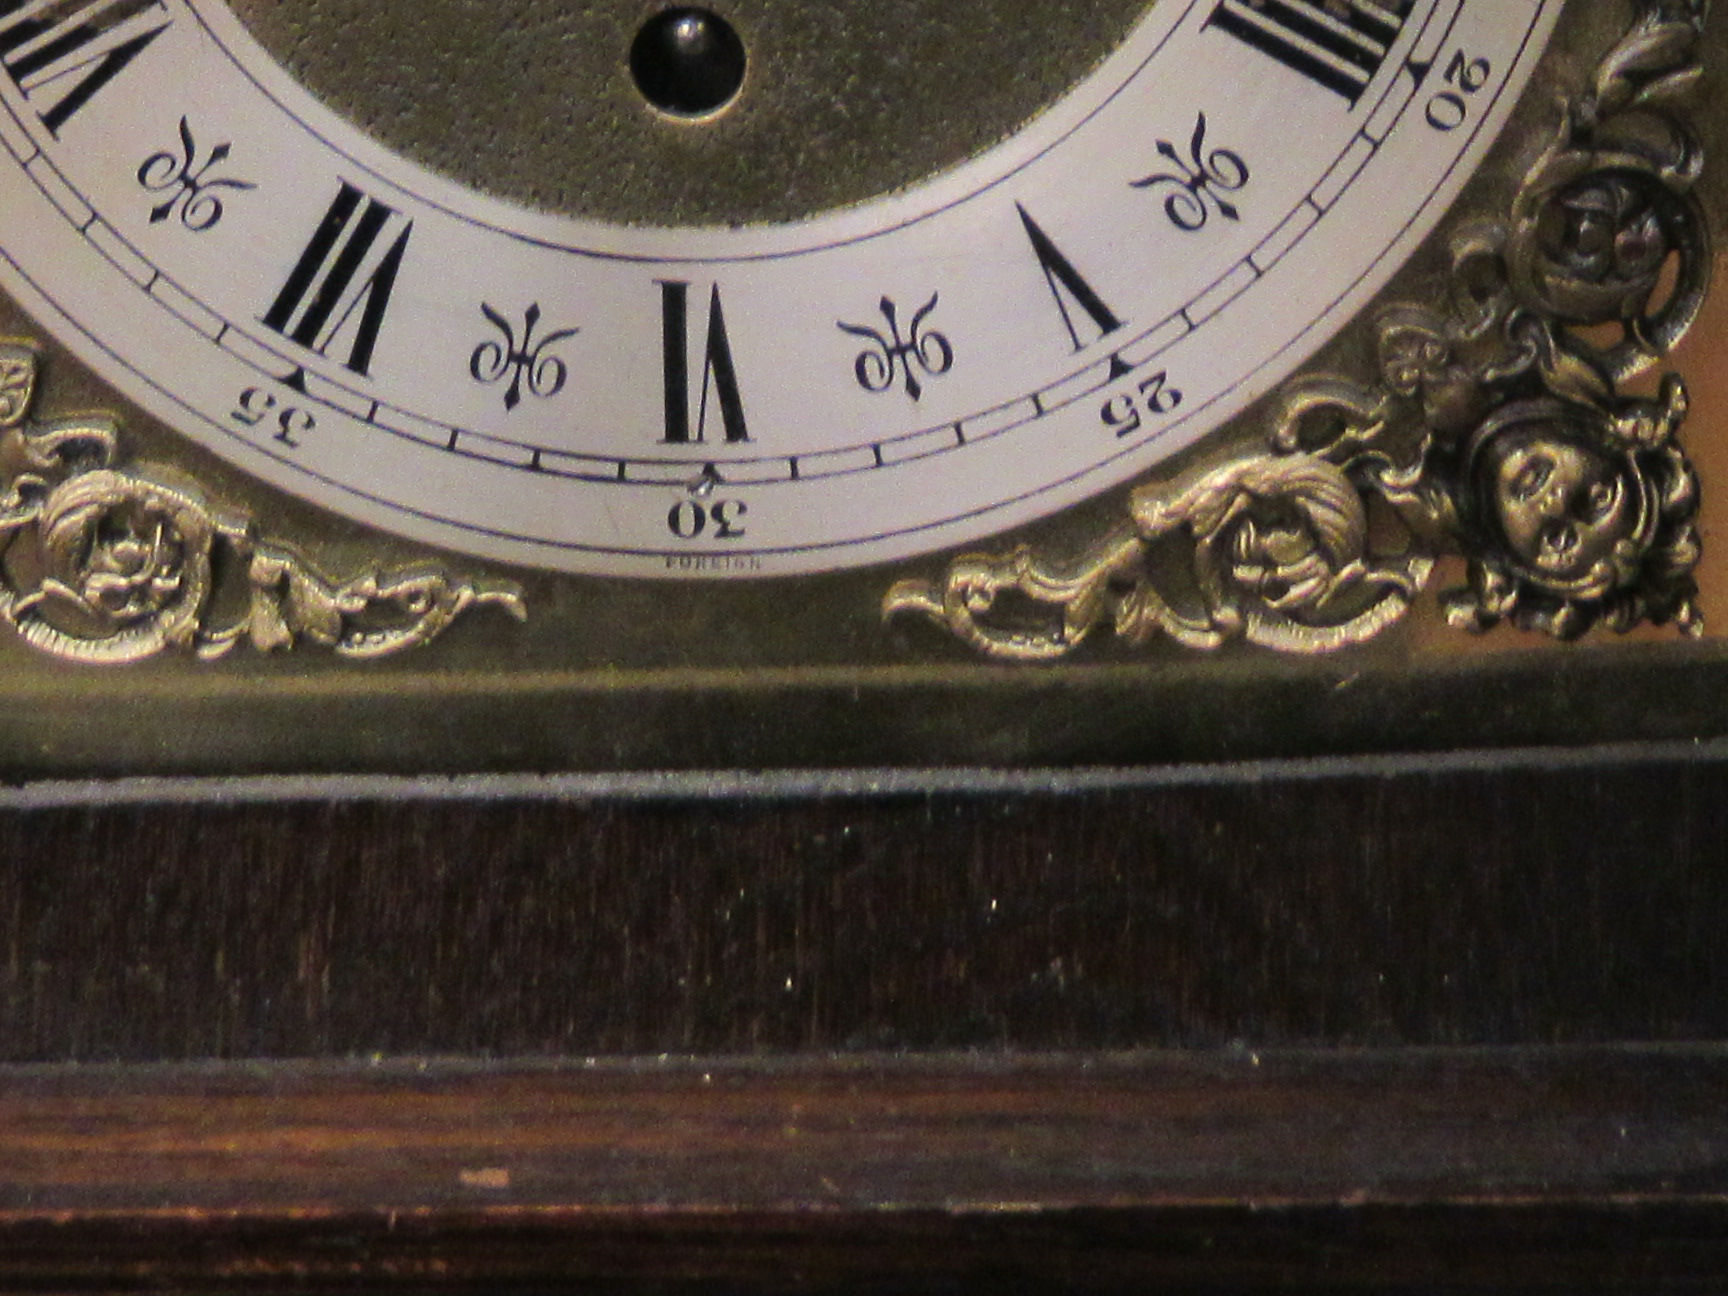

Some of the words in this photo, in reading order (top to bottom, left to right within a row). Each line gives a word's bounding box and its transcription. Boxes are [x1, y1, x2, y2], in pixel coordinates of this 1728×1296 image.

[1425, 48, 1491, 132] 20
[254, 175, 414, 381] VII
[1014, 200, 1130, 356] V
[652, 279, 757, 444] VI
[230, 386, 316, 449] 35
[1100, 370, 1183, 439] 25
[667, 499, 748, 539] 30
